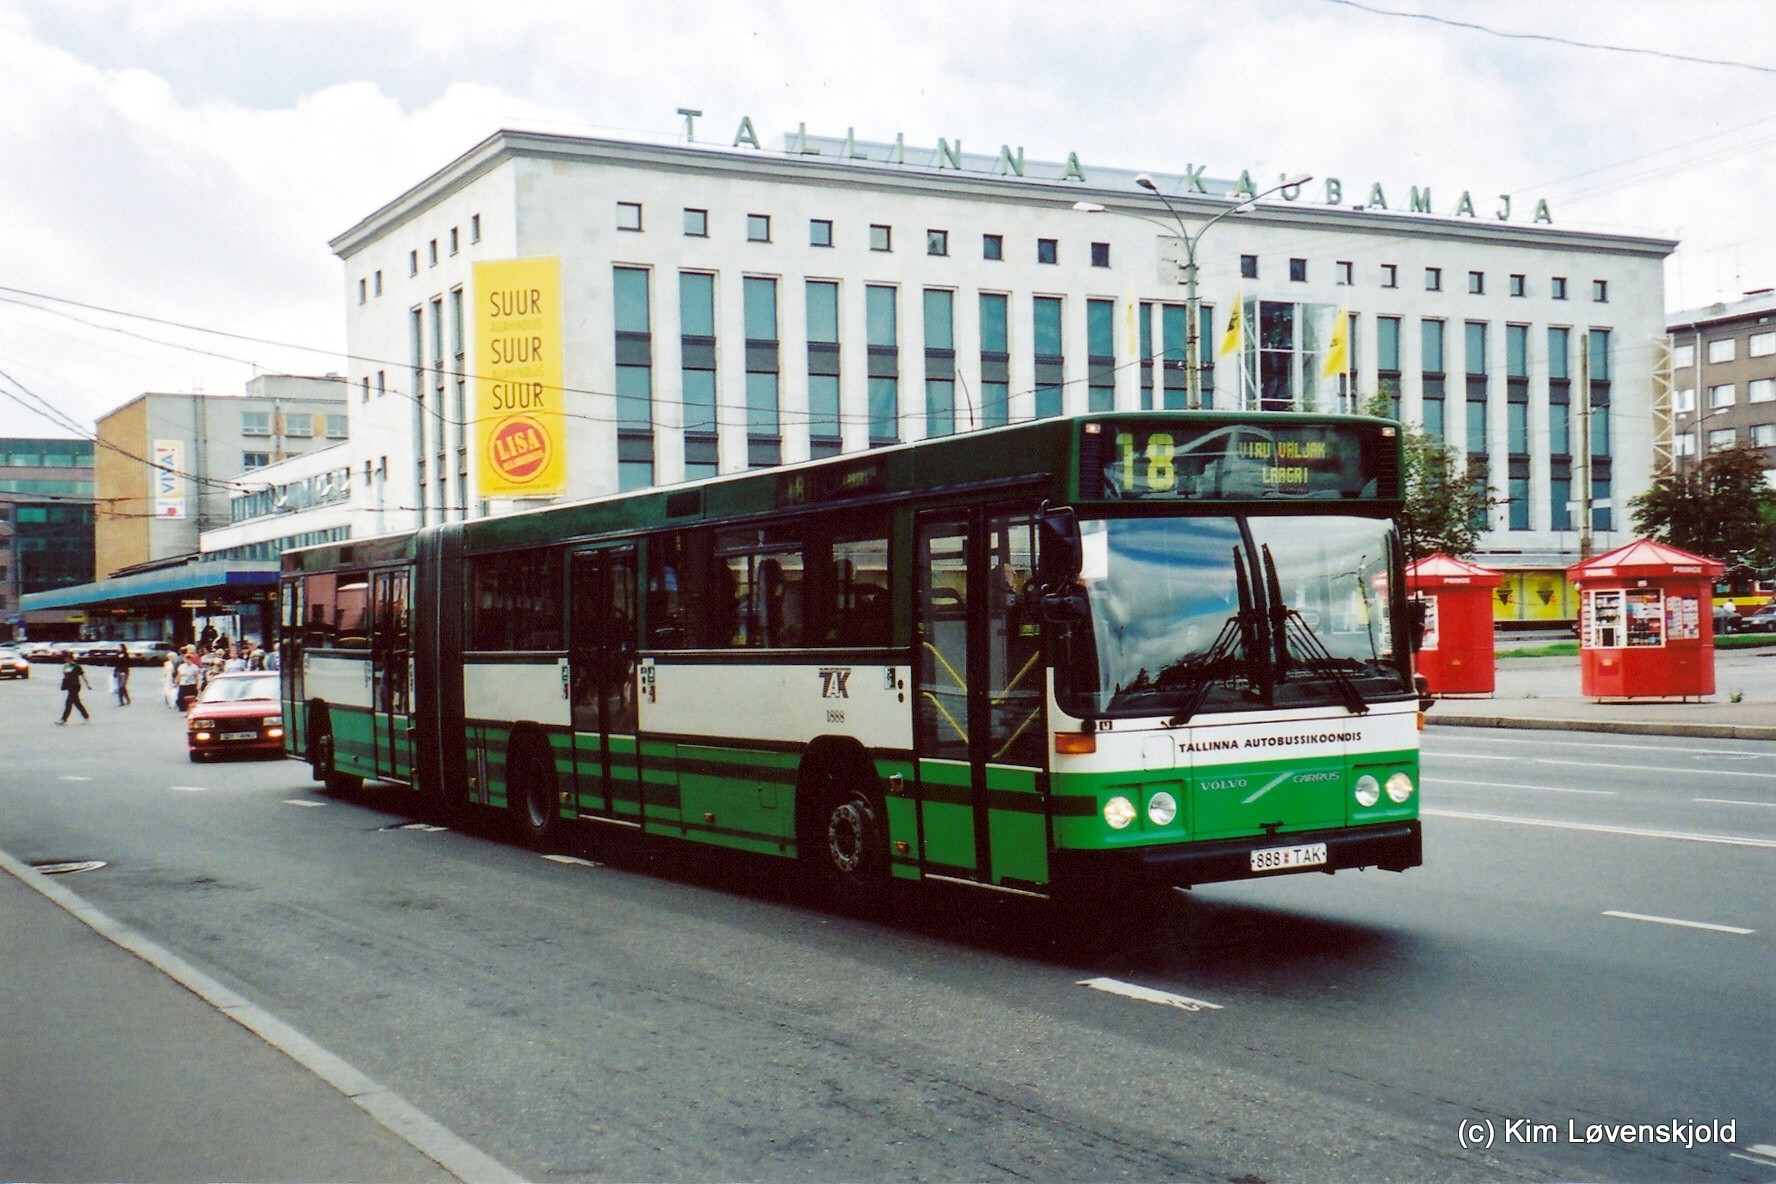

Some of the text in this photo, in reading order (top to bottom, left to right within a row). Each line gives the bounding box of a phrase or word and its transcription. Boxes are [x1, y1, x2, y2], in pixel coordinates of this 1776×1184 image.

[677, 108, 1553, 225] TALLINNA KAUBAMAJA
[490, 288, 542, 317] SUUR
[491, 336, 543, 364] SUUR
[492, 382, 544, 410] SUUR
[495, 428, 542, 461] LISA
[1116, 433, 1174, 491] 18
[826, 709, 845, 723] 1888
[1179, 732, 1362, 753] TALLINNA AUTOBUSSIKOONDIS
[1200, 779, 1248, 791] VOLVO
[1293, 771, 1340, 784] CARRUS
[1256, 847, 1321, 868] 888 TAK
